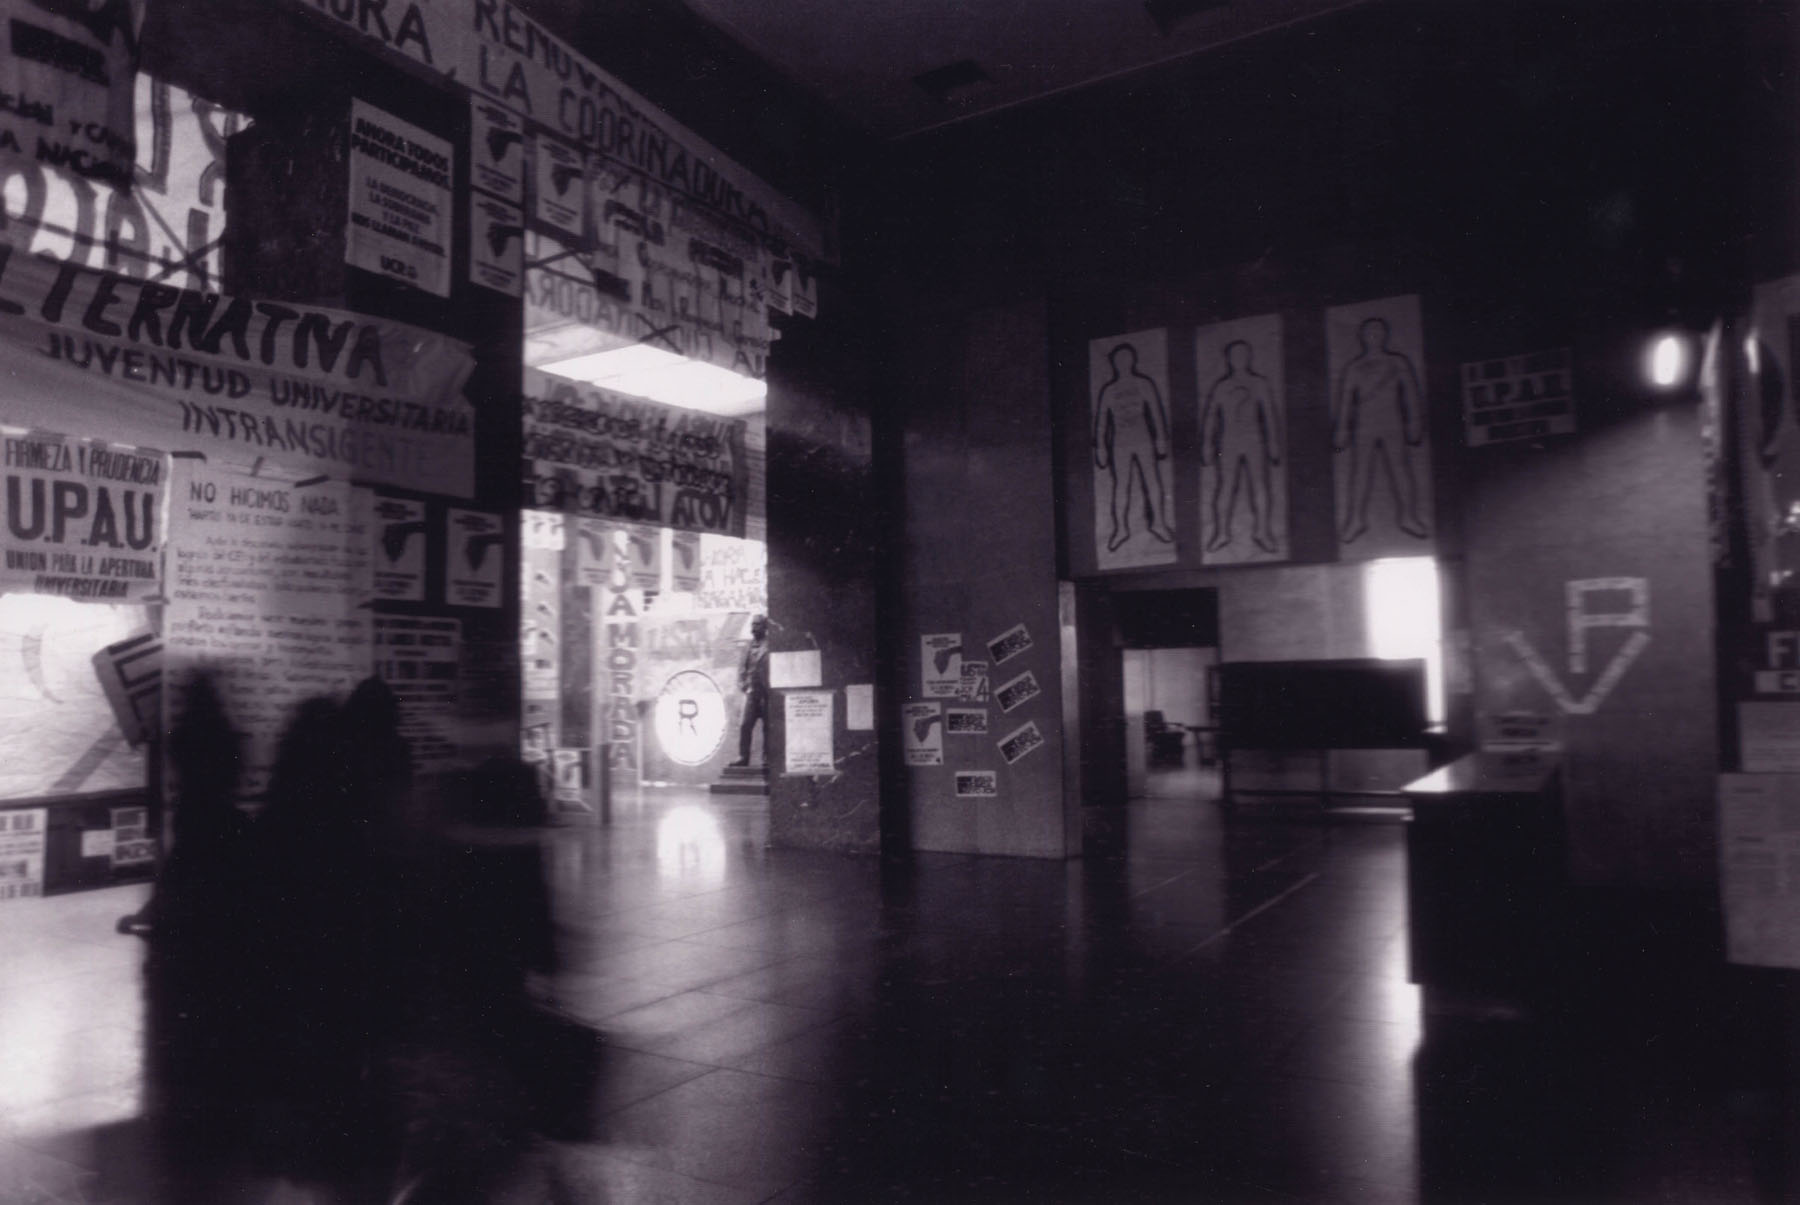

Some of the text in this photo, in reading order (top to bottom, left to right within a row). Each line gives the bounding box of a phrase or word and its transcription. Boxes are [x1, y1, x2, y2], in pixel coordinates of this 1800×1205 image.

[479, 44, 533, 114] LA
[39, 333, 250, 399] JUVENTUD
[270, 378, 470, 436] UNIVERSITARIA
[6, 438, 160, 485] FIRMEZA Y PRUDENCIA
[7, 475, 157, 552] U.P.A.U.
[189, 481, 216, 503] NO
[230, 486, 290, 512] HICIMOS
[6, 550, 46, 571] UNION
[80, 555, 93, 575] LA
[34, 575, 128, 598] UNIVERSITARIA
